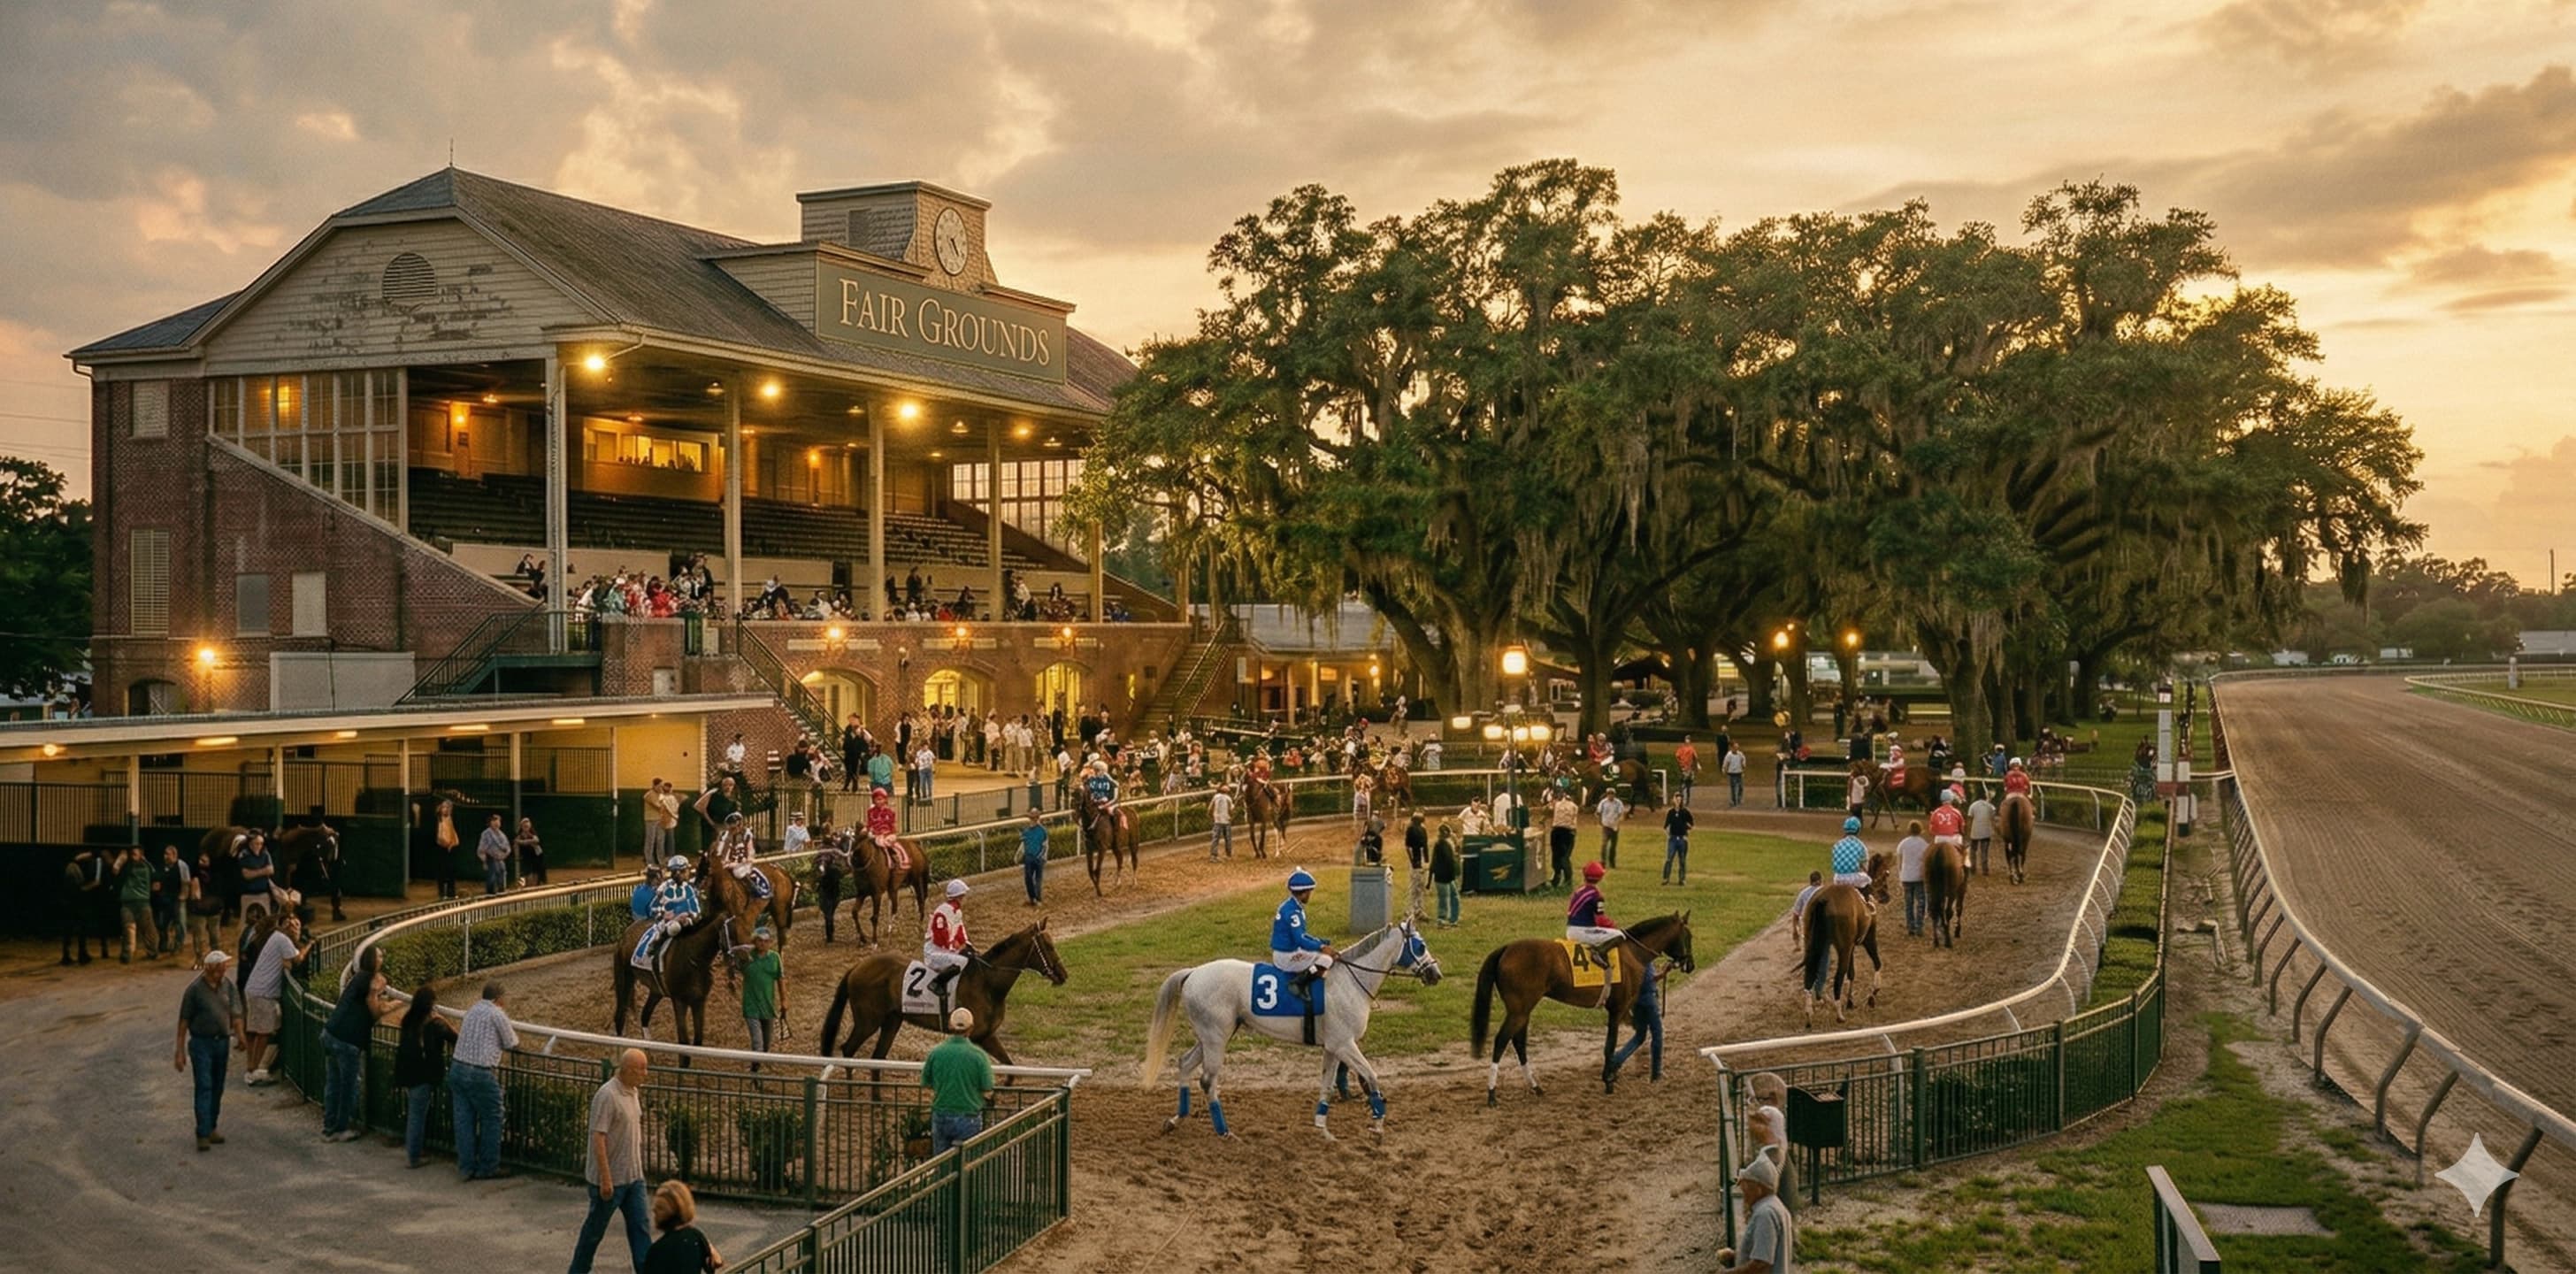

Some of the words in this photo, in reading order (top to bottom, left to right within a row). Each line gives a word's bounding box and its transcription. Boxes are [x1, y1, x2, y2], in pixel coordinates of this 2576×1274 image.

[840, 278, 908, 338] FAIR
[918, 298, 1050, 365] GROUNDS
[1291, 914, 1300, 927] 3
[1574, 944, 1589, 971] 4
[907, 967, 927, 997] 2
[1257, 975, 1278, 1009] 3
